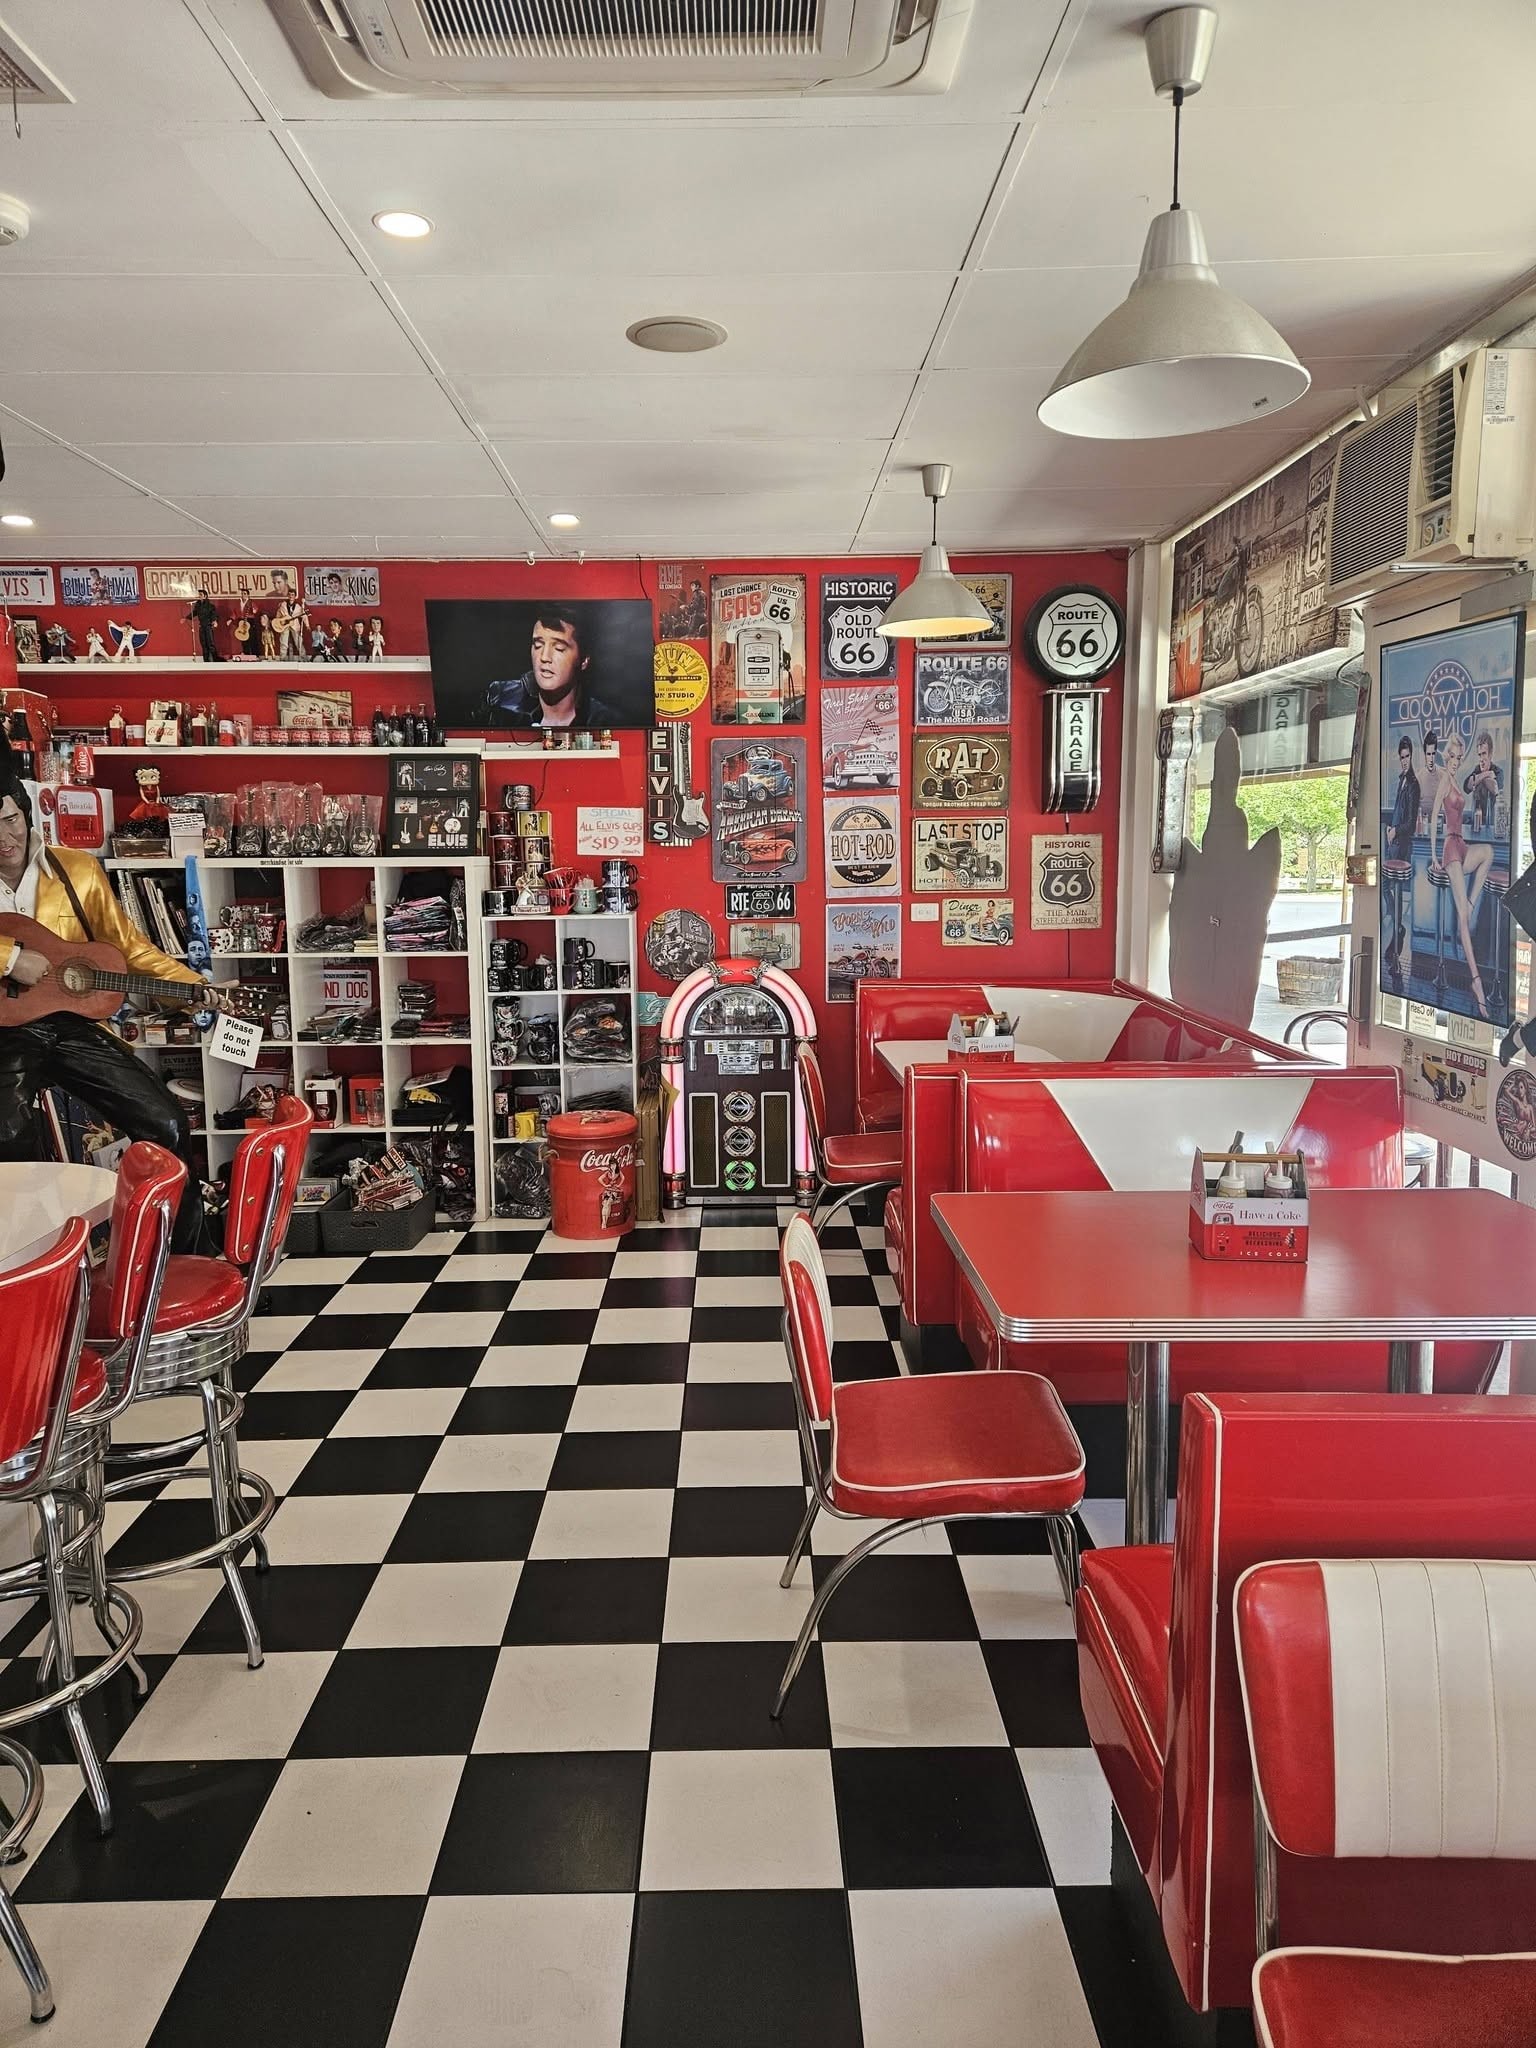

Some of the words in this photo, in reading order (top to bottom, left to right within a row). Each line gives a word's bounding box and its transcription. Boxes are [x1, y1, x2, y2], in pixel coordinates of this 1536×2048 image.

[3, 577, 29, 597] VIS
[64, 577, 92, 597] BLUE
[237, 573, 267, 591] BLVD
[307, 576, 328, 596] THE
[348, 576, 376, 597] KING
[720, 587, 736, 598] LAST
[737, 582, 761, 595] CHANCE
[825, 581, 893, 596] HISTORIC
[975, 585, 986, 594] 66
[772, 586, 798, 597] ROUTE
[1303, 584, 1325, 612] ROUT
[721, 590, 762, 621] GAS
[777, 597, 788, 605] US
[769, 604, 791, 621] 66
[844, 614, 872, 625] OLD
[1057, 610, 1099, 620] ROUTE
[836, 627, 880, 639] ROUTE
[1056, 628, 1099, 658] 66
[840, 642, 875, 664] 66
[919, 656, 983, 673] ROUTE
[985, 656, 1008, 671] 66
[878, 701, 890, 710] 66
[954, 709, 972, 717] USA
[977, 715, 1000, 723] Road
[1069, 701, 1084, 771] GARAGE
[76, 751, 88, 773] Coke
[935, 742, 990, 773] RAT
[650, 730, 670, 840] ELVIS
[579, 821, 595, 832] ALL
[596, 820, 620, 830] ELVIS
[622, 821, 643, 831] CUPS
[918, 823, 959, 842] LAST
[962, 823, 1004, 841] STOP
[427, 834, 468, 847] ELVIS
[831, 834, 896, 862] HOT-ROD
[1044, 841, 1091, 849] HISTORIC
[1050, 859, 1083, 869] ROUTE
[1050, 874, 1082, 897] 66
[730, 892, 750, 911] RTE
[776, 891, 791, 911] 66
[755, 899, 770, 910] 66
[948, 899, 982, 913] Diner
[949, 928, 961, 937] 66
[346, 981, 369, 998] DOG
[225, 1018, 254, 1036] Please
[223, 1032, 234, 1043] do
[235, 1035, 251, 1047] not
[222, 1042, 247, 1058] touch
[1446, 1049, 1461, 1063] HOT
[1463, 1053, 1487, 1070] RODS
[1239, 1210, 1266, 1221] Have
[1276, 1210, 1302, 1221] Coke
